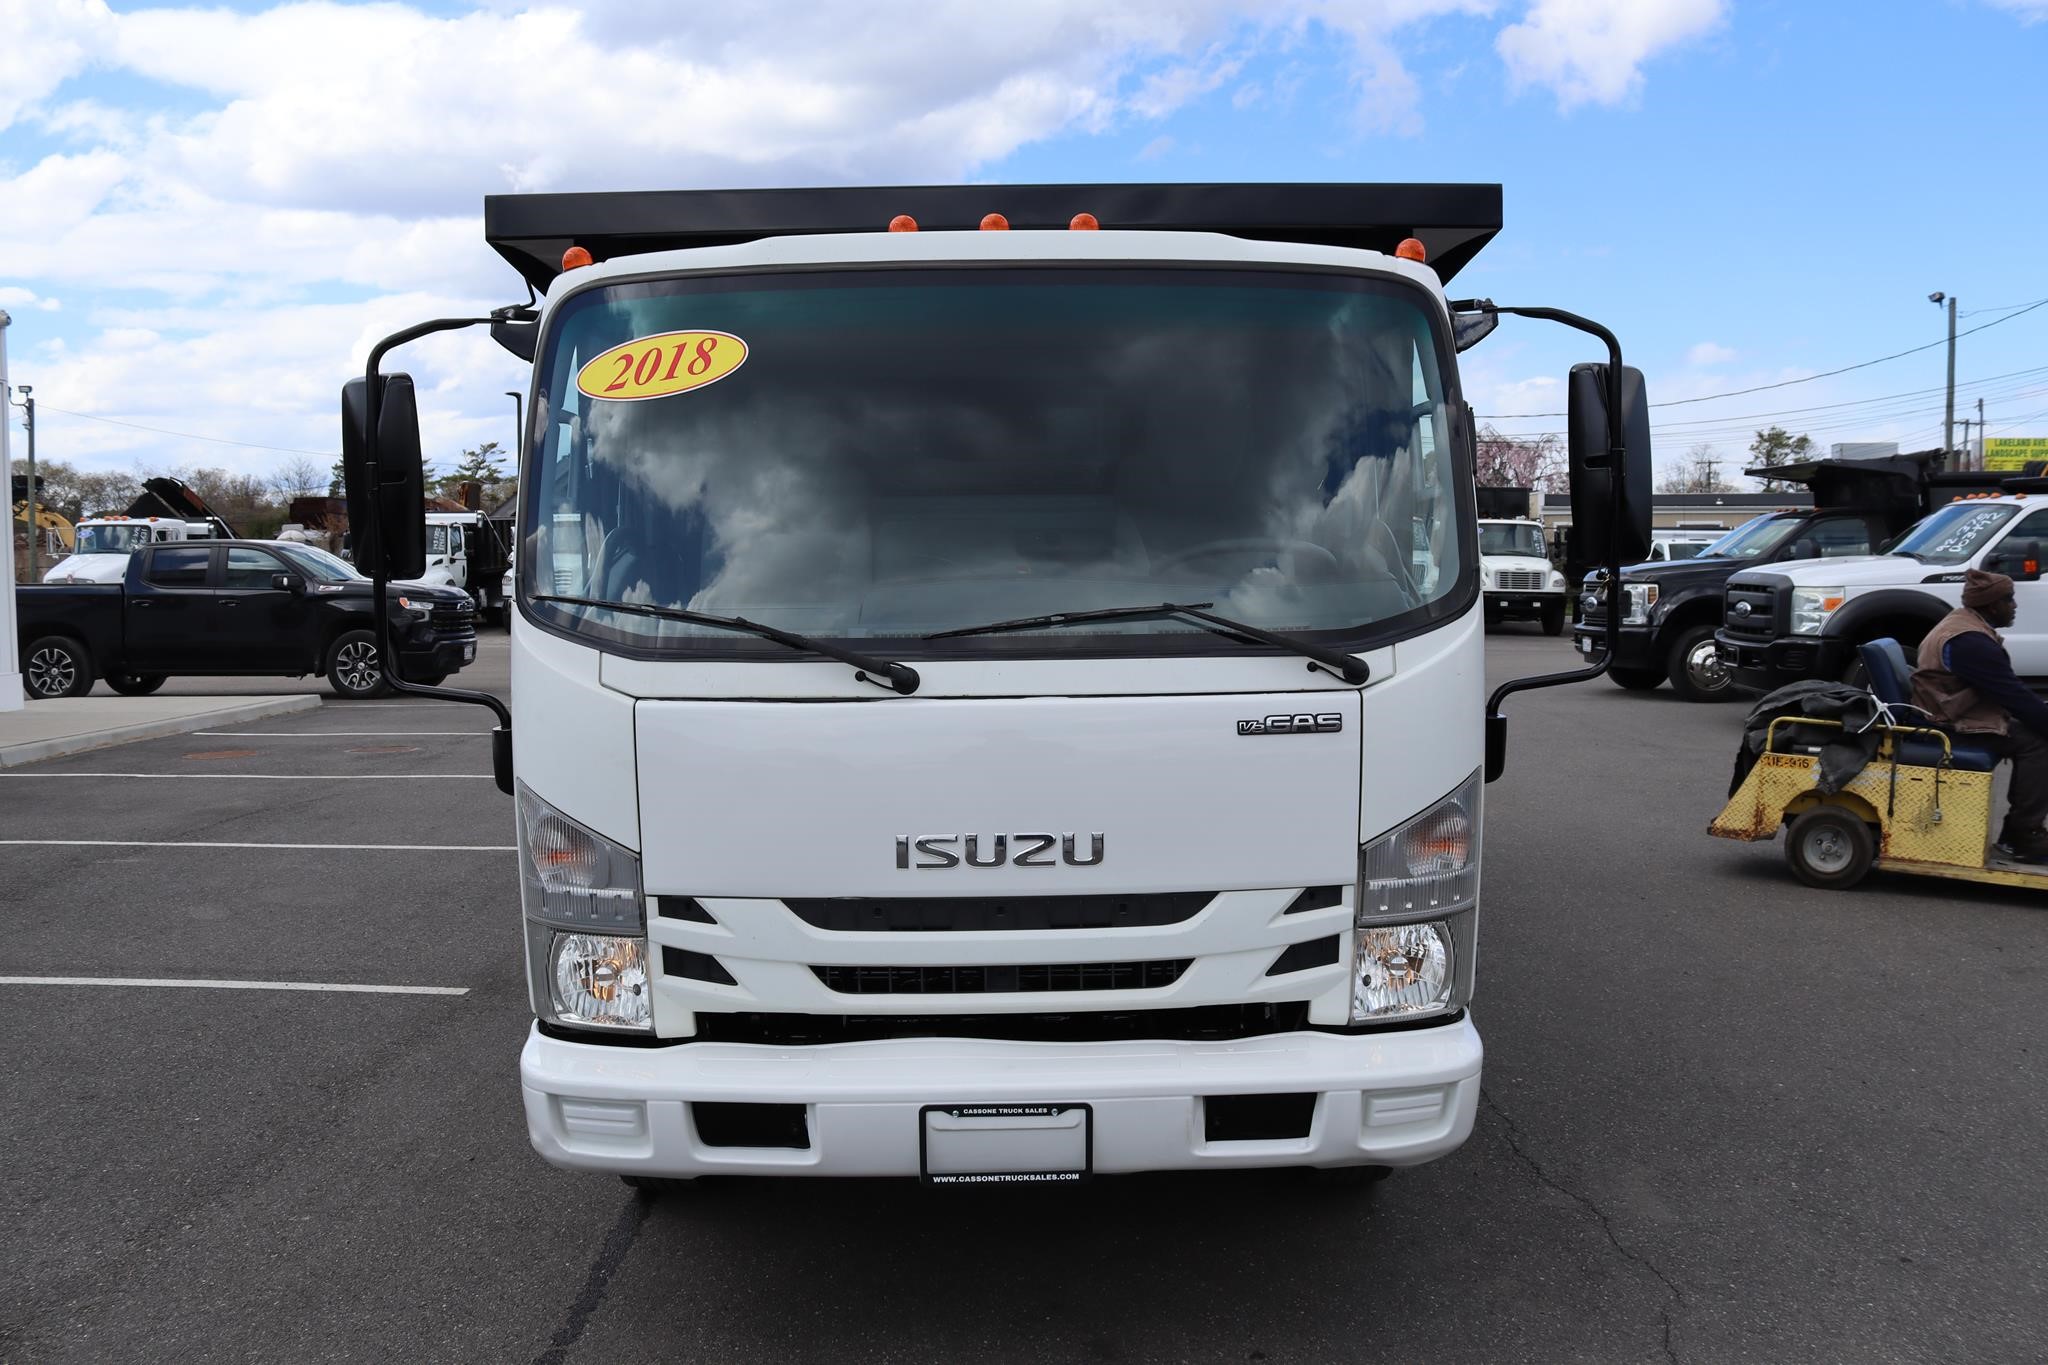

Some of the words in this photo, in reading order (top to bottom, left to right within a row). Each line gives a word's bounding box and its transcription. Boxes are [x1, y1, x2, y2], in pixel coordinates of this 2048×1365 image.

[603, 337, 718, 392] 2018
[1985, 449, 2028, 457] LANDSCAPE
[1265, 713, 1342, 733] GAS
[896, 832, 1104, 869] ISUZU
[933, 1173, 1080, 1183] WWW.CASSONETRUCKSALES.COM
